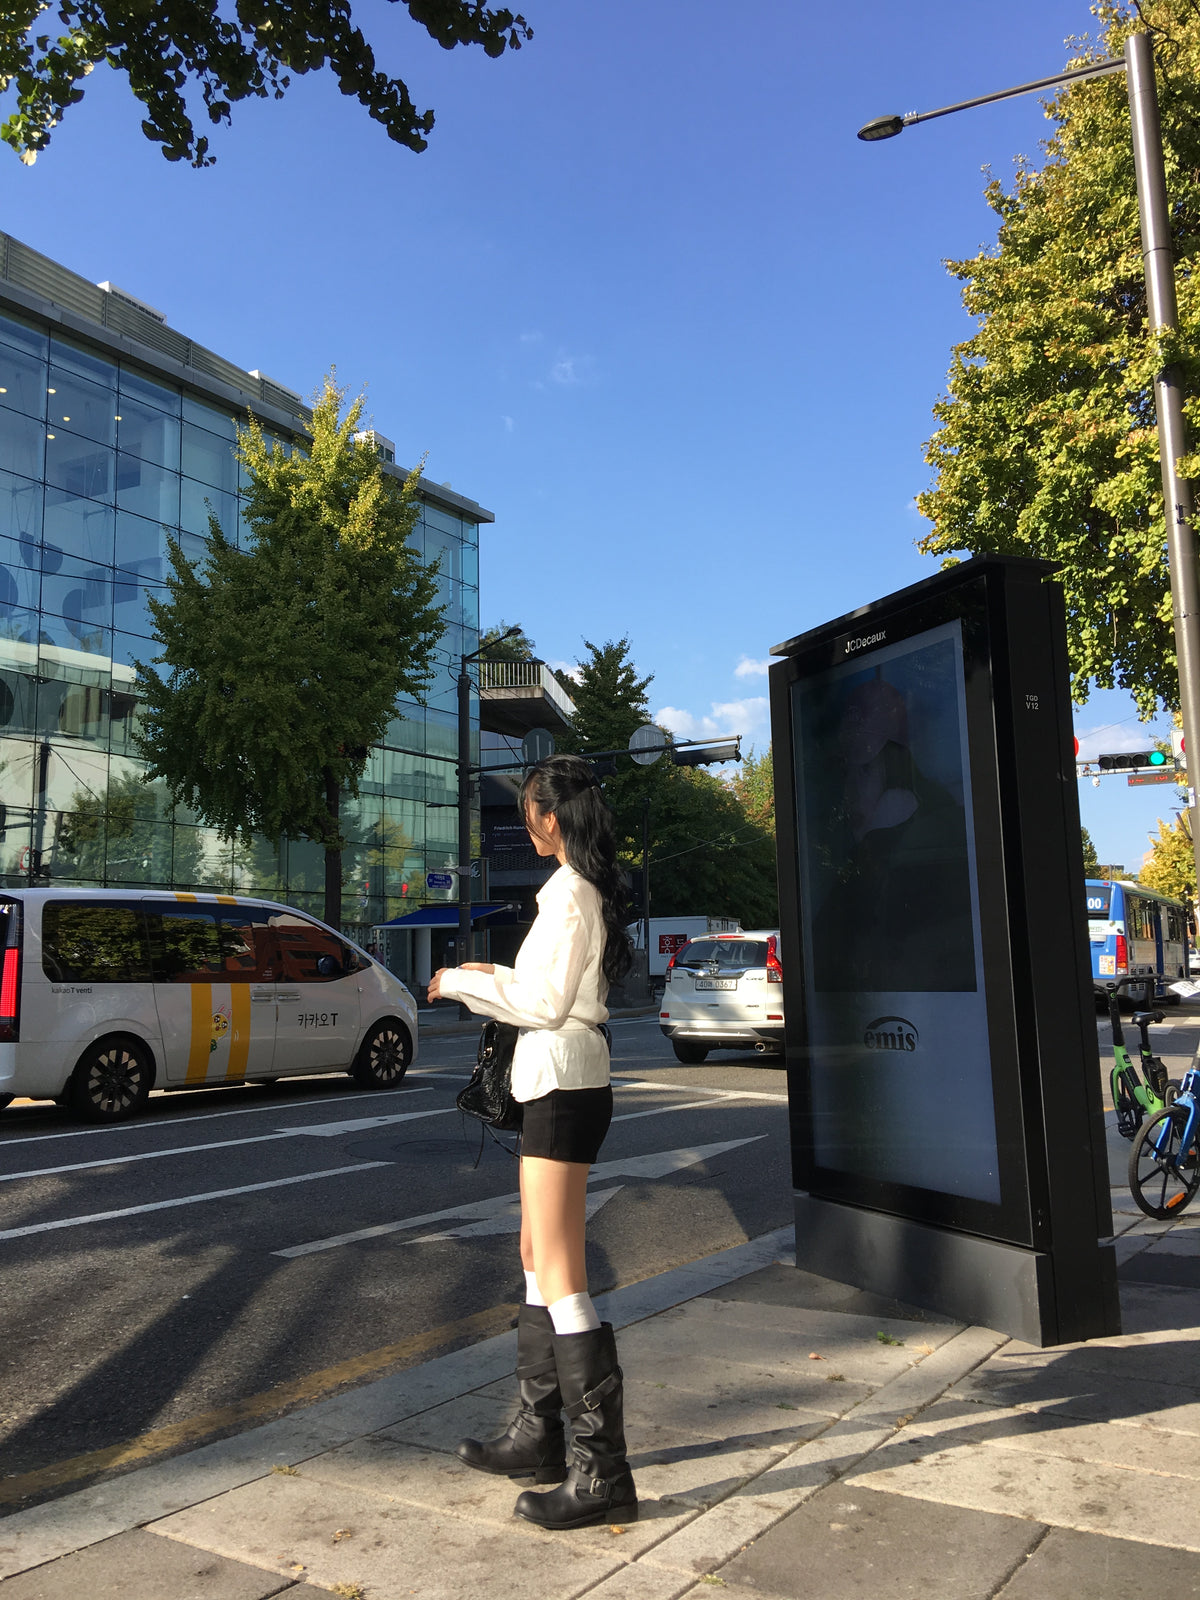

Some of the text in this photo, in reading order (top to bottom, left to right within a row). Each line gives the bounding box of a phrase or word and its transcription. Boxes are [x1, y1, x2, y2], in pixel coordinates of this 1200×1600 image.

[845, 630, 887, 653] JCDecaux
[1026, 701, 1039, 710] V12
[76, 986, 92, 994] venti
[298, 1013, 338, 1029] 카카오 T
[864, 1026, 916, 1052] emis
